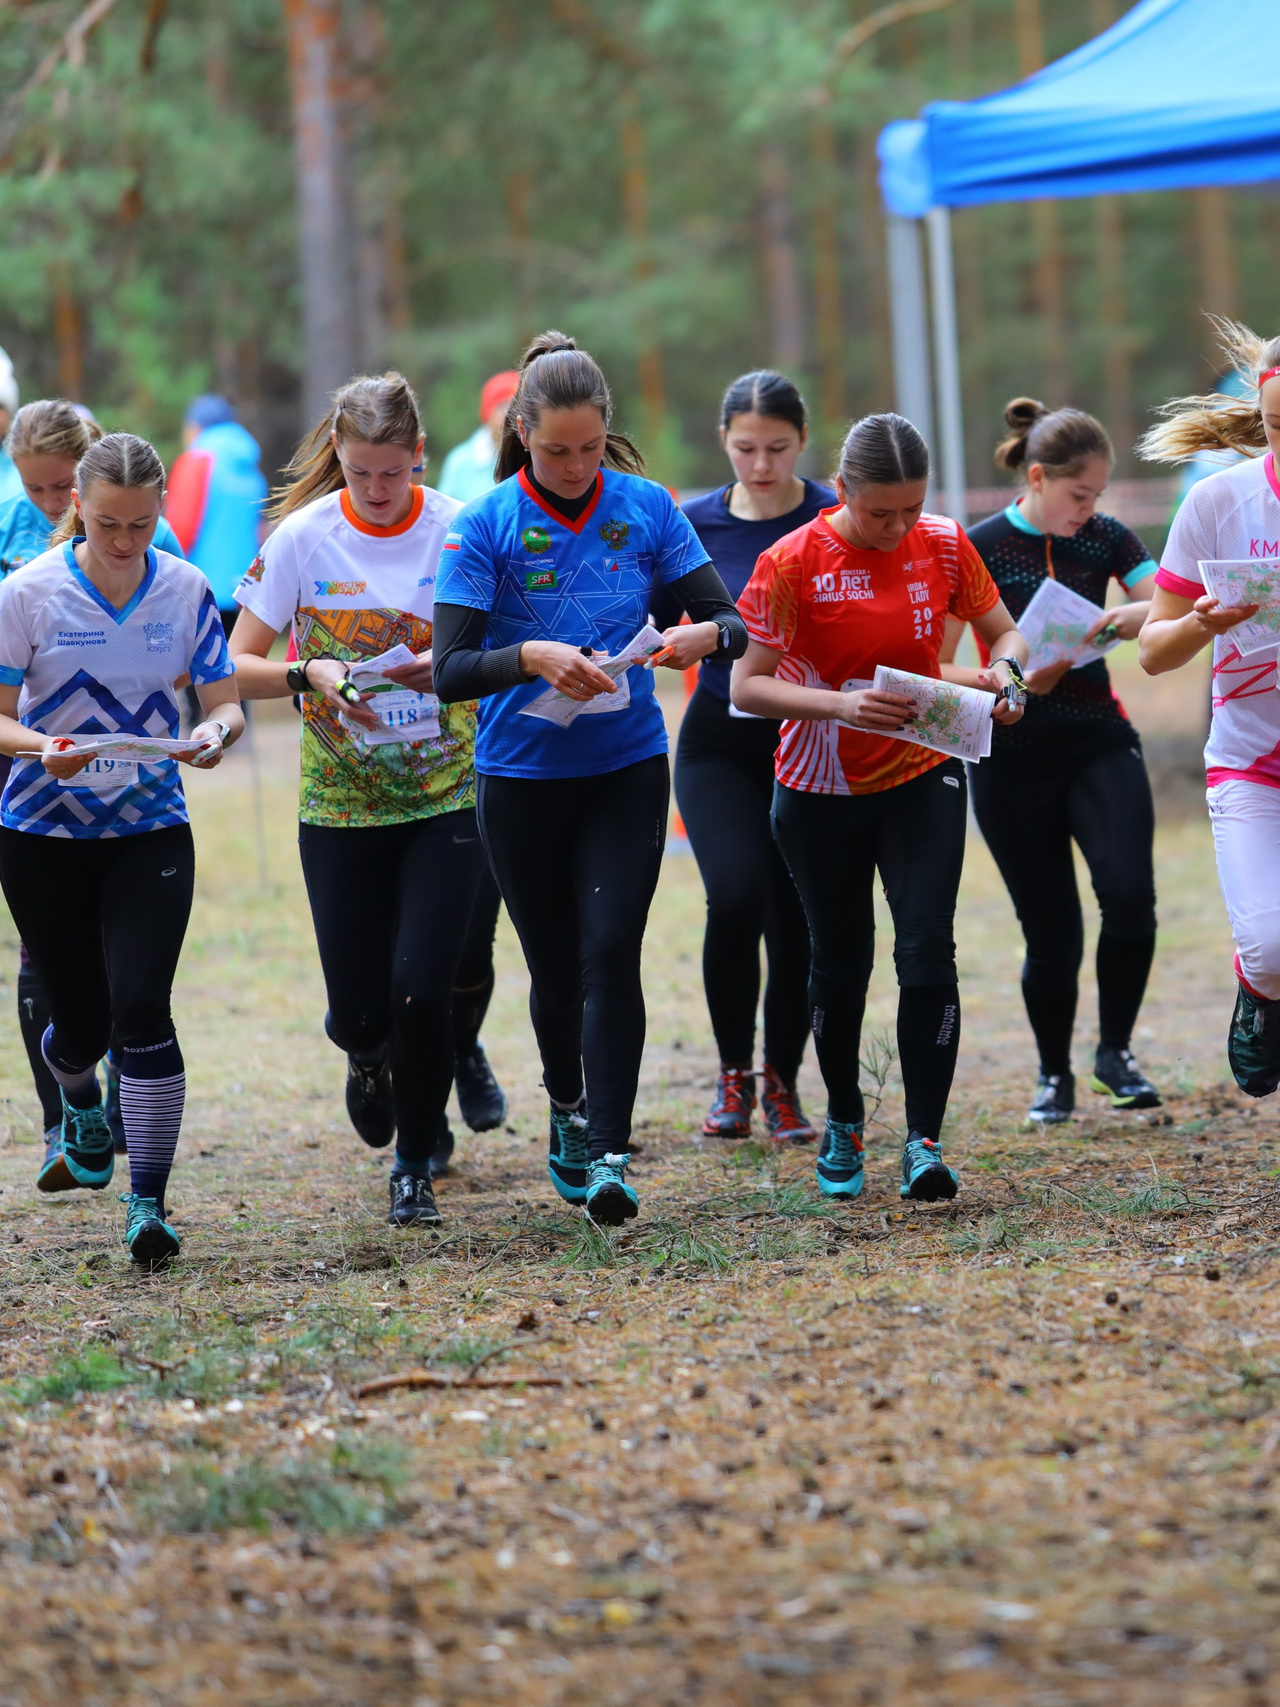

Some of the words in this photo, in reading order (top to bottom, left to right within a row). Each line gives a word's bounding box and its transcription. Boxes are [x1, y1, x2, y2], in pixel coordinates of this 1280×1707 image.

[1250, 538, 1280, 558] KM
[531, 574, 552, 585] SFR
[811, 573, 836, 593] 10
[840, 575, 872, 591] лет
[906, 581, 923, 593] IRON
[813, 591, 846, 603] SIRIUS
[847, 589, 875, 600] SOCHI
[909, 589, 931, 605] LADY
[58, 630, 105, 639] Екатерина
[57, 638, 107, 647] Шавкунова
[146, 645, 173, 654] ЮУрГУ
[387, 708, 418, 727] 118
[936, 1004, 957, 1046] noname
[122, 1038, 174, 1053] noname
